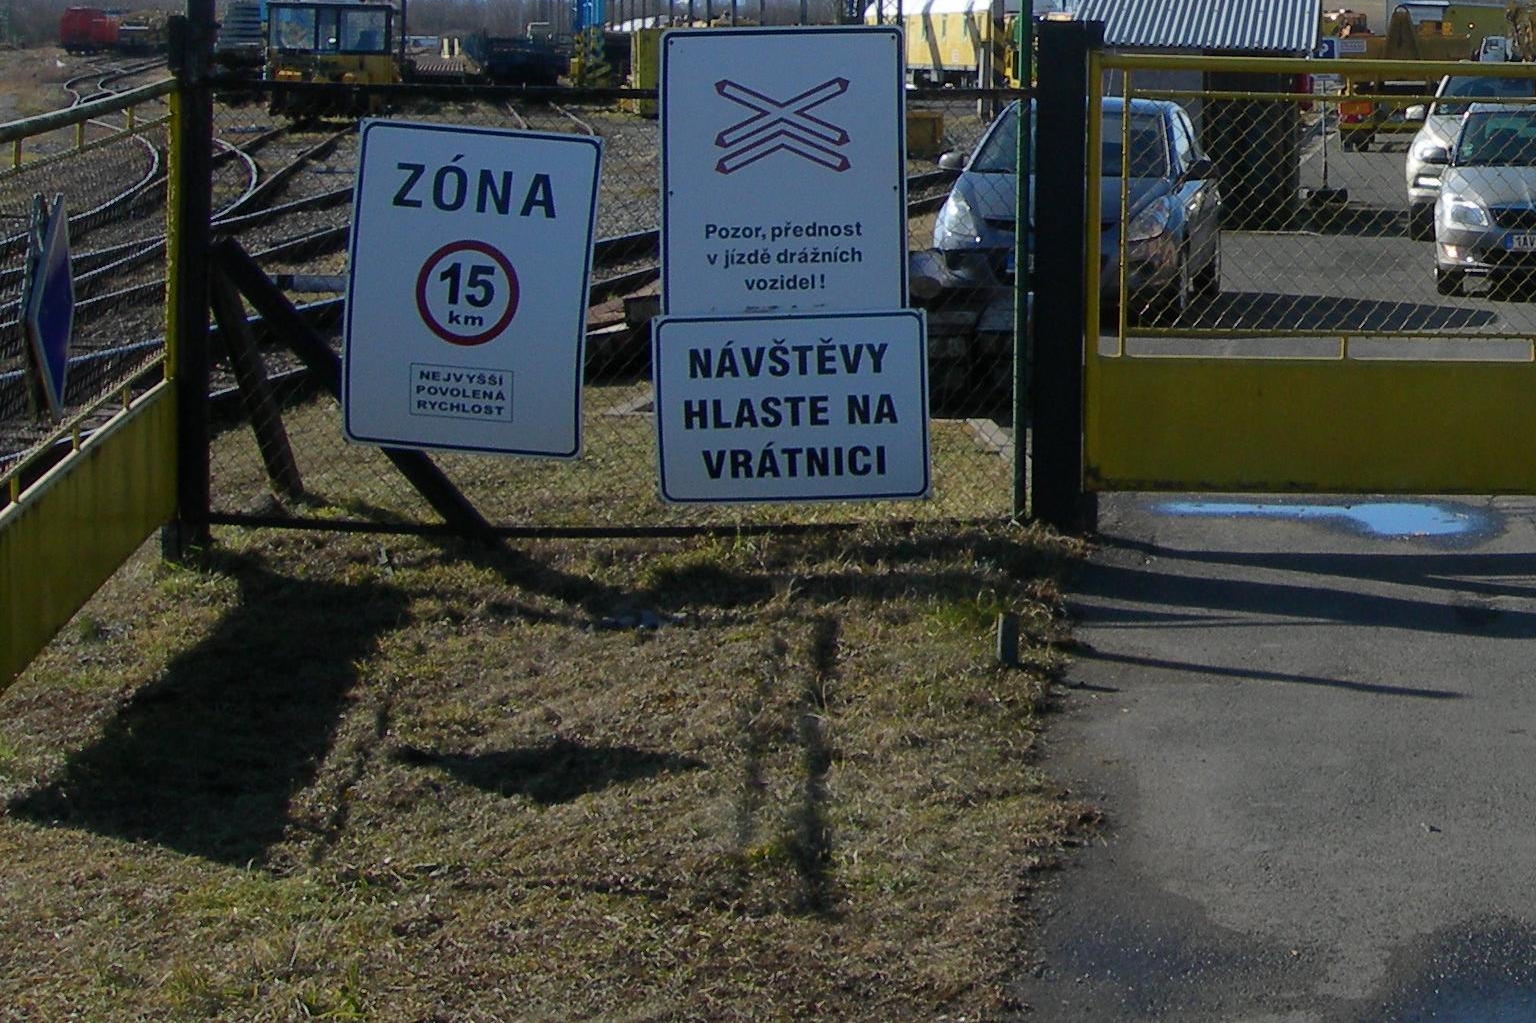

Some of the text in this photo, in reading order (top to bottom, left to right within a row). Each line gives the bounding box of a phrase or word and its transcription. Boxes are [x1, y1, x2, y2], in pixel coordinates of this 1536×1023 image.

[393, 154, 556, 218] ZÓNA
[705, 222, 862, 241] Pozor, přednost
[707, 246, 862, 268] v jízdě drážních
[440, 262, 495, 308] 15
[448, 310, 483, 326] km
[688, 337, 889, 379] NÁVŠTĚVY
[417, 400, 505, 415] RYCHLOST
[684, 393, 898, 429] HLASTE NA
[702, 441, 887, 479] VRÁTNICI
